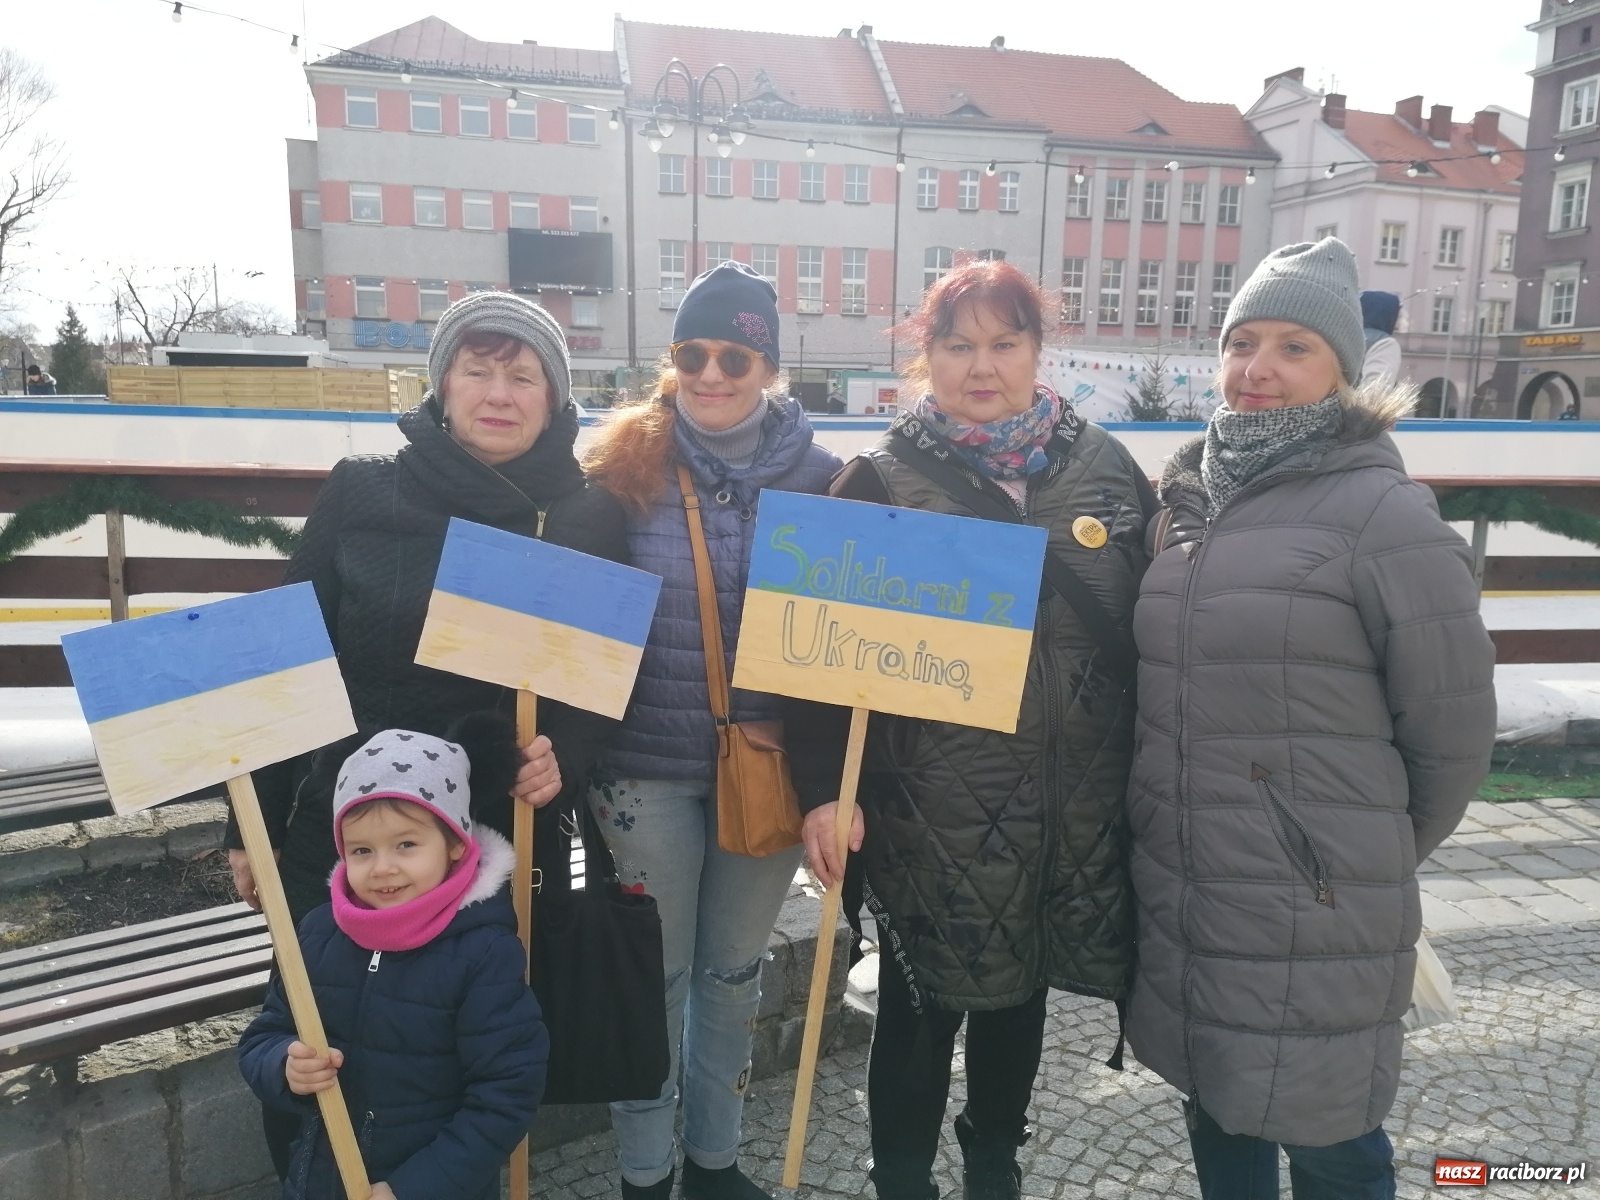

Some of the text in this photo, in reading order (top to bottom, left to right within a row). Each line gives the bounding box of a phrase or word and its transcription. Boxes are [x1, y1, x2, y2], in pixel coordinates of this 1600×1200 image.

[353, 319, 433, 348] BOL
[245, 497, 258, 506] 05
[1080, 522, 1100, 539] EKIPA
[758, 524, 971, 615] Solidarni
[781, 600, 974, 702] Ukrainą
